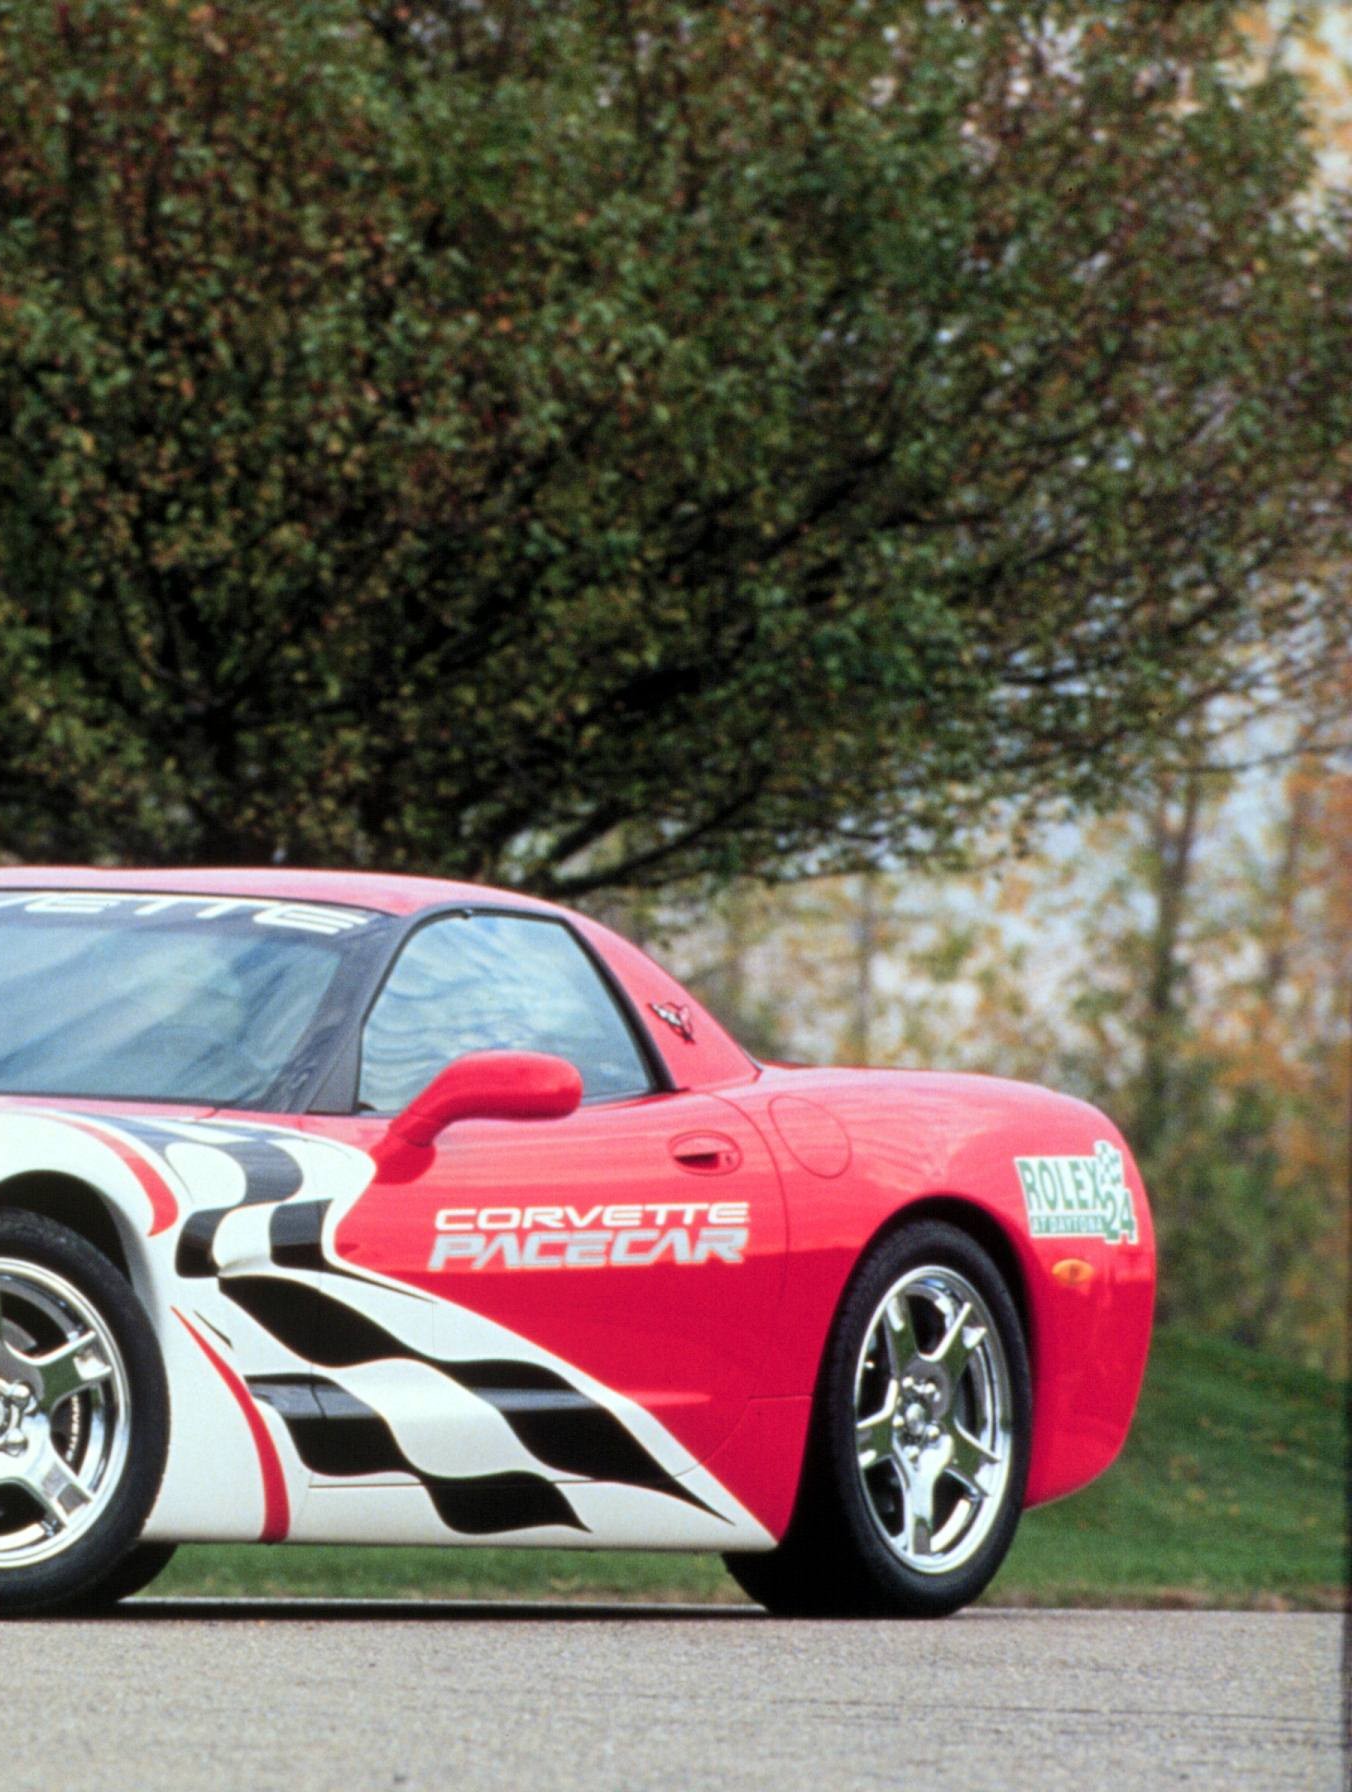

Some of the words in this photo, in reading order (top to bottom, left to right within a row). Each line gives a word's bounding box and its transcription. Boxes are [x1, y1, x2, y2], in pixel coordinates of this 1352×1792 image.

[434, 1202, 750, 1231] CORVETTE
[1017, 1160, 1107, 1210] ROLEX
[1103, 1188, 1137, 1242] 24
